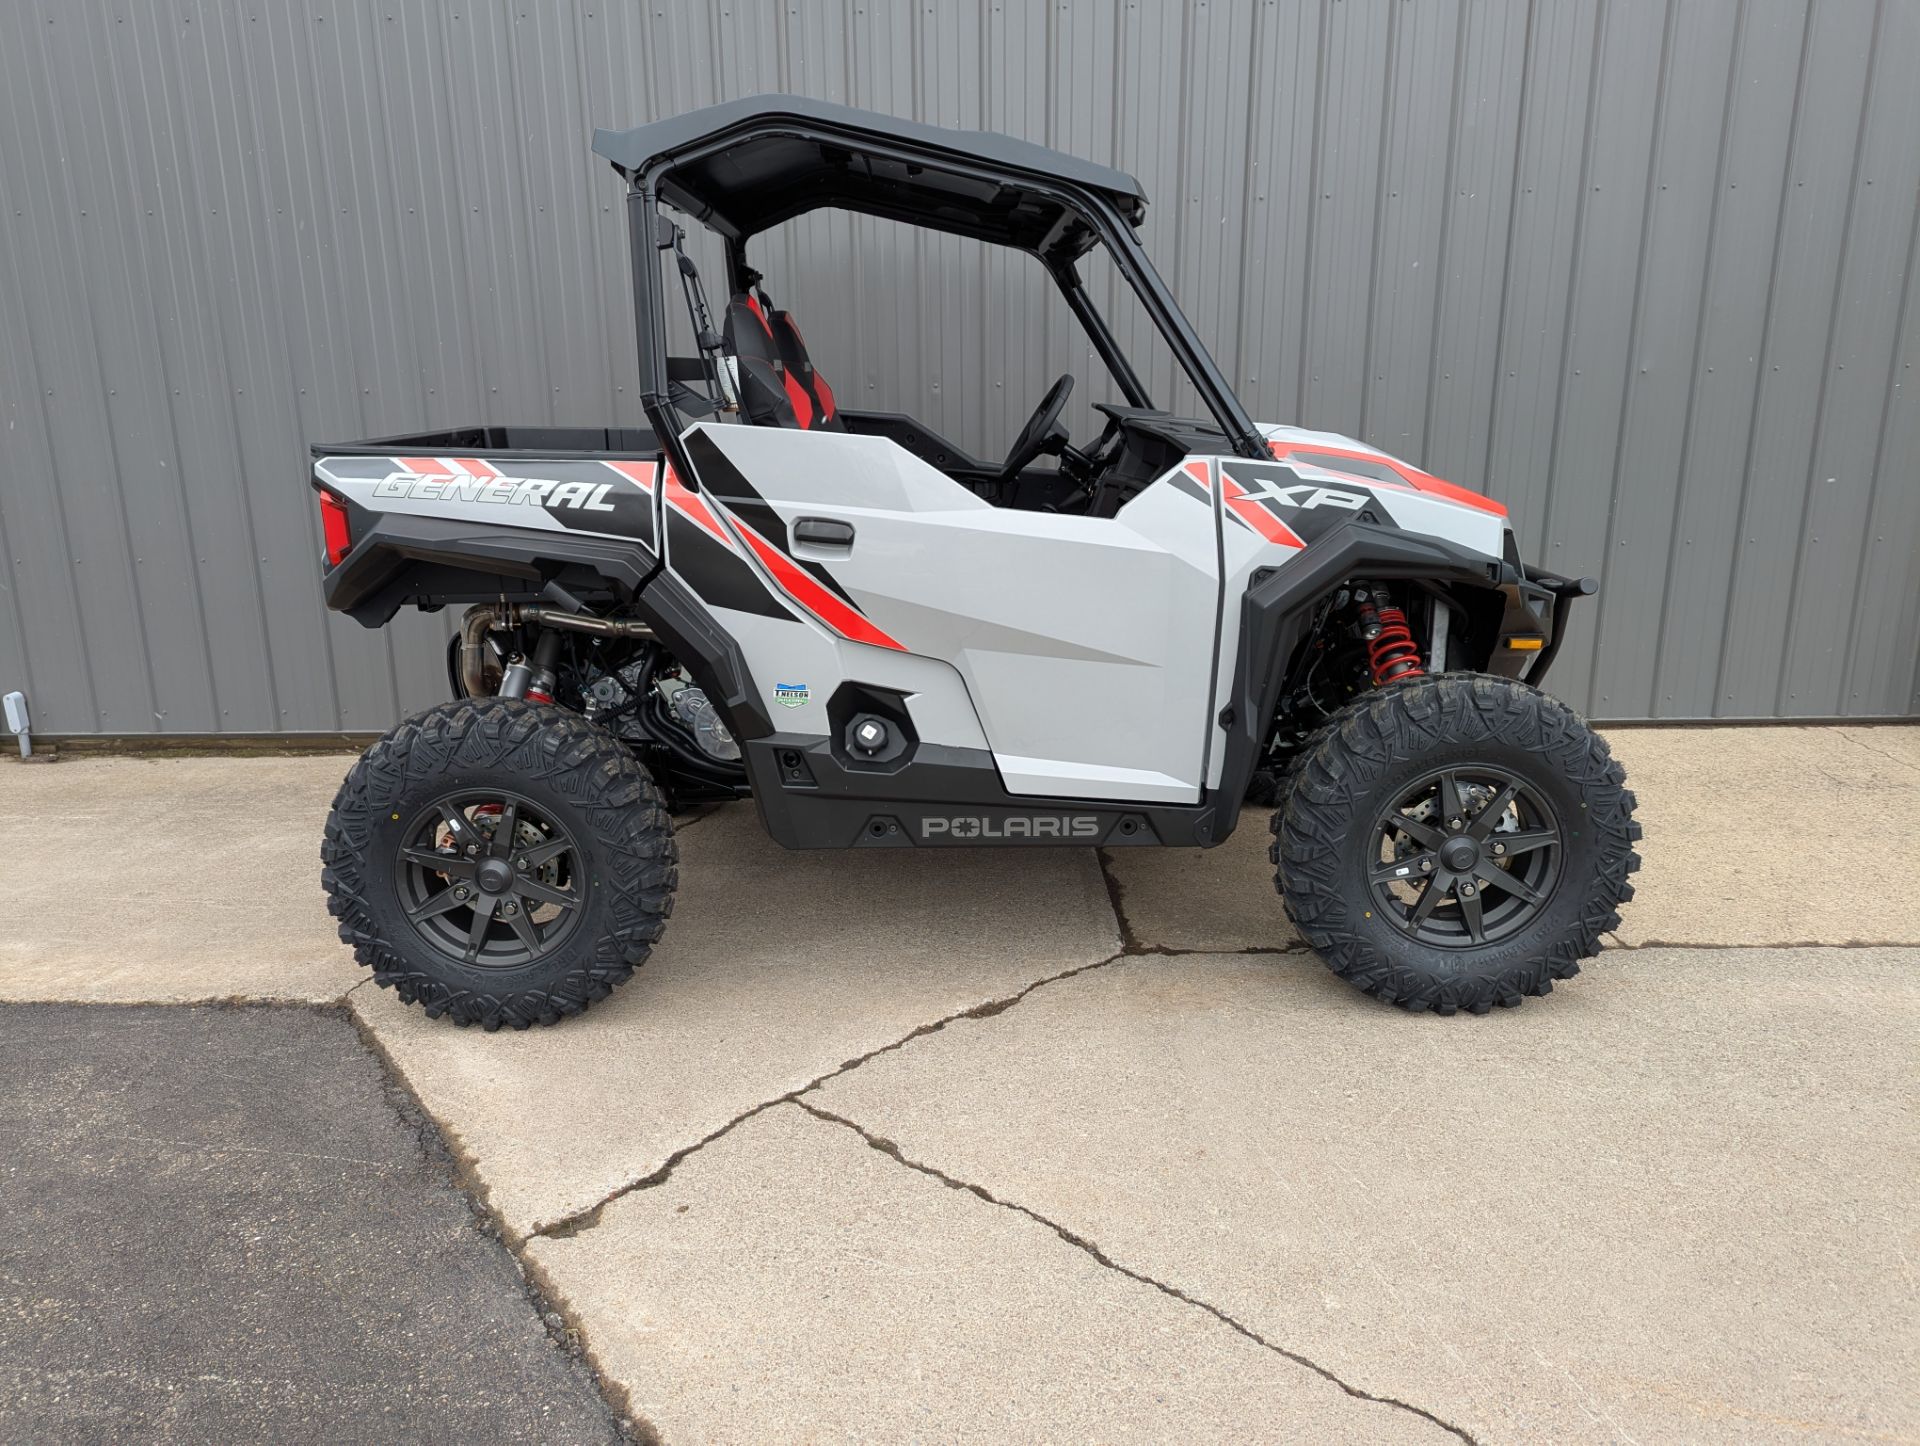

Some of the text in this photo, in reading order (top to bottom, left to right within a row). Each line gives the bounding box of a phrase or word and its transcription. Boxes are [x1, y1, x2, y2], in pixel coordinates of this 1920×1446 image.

[372, 472, 615, 512] GENERAL
[1232, 478, 1371, 511] XP
[922, 816, 1099, 838] POLARIS
